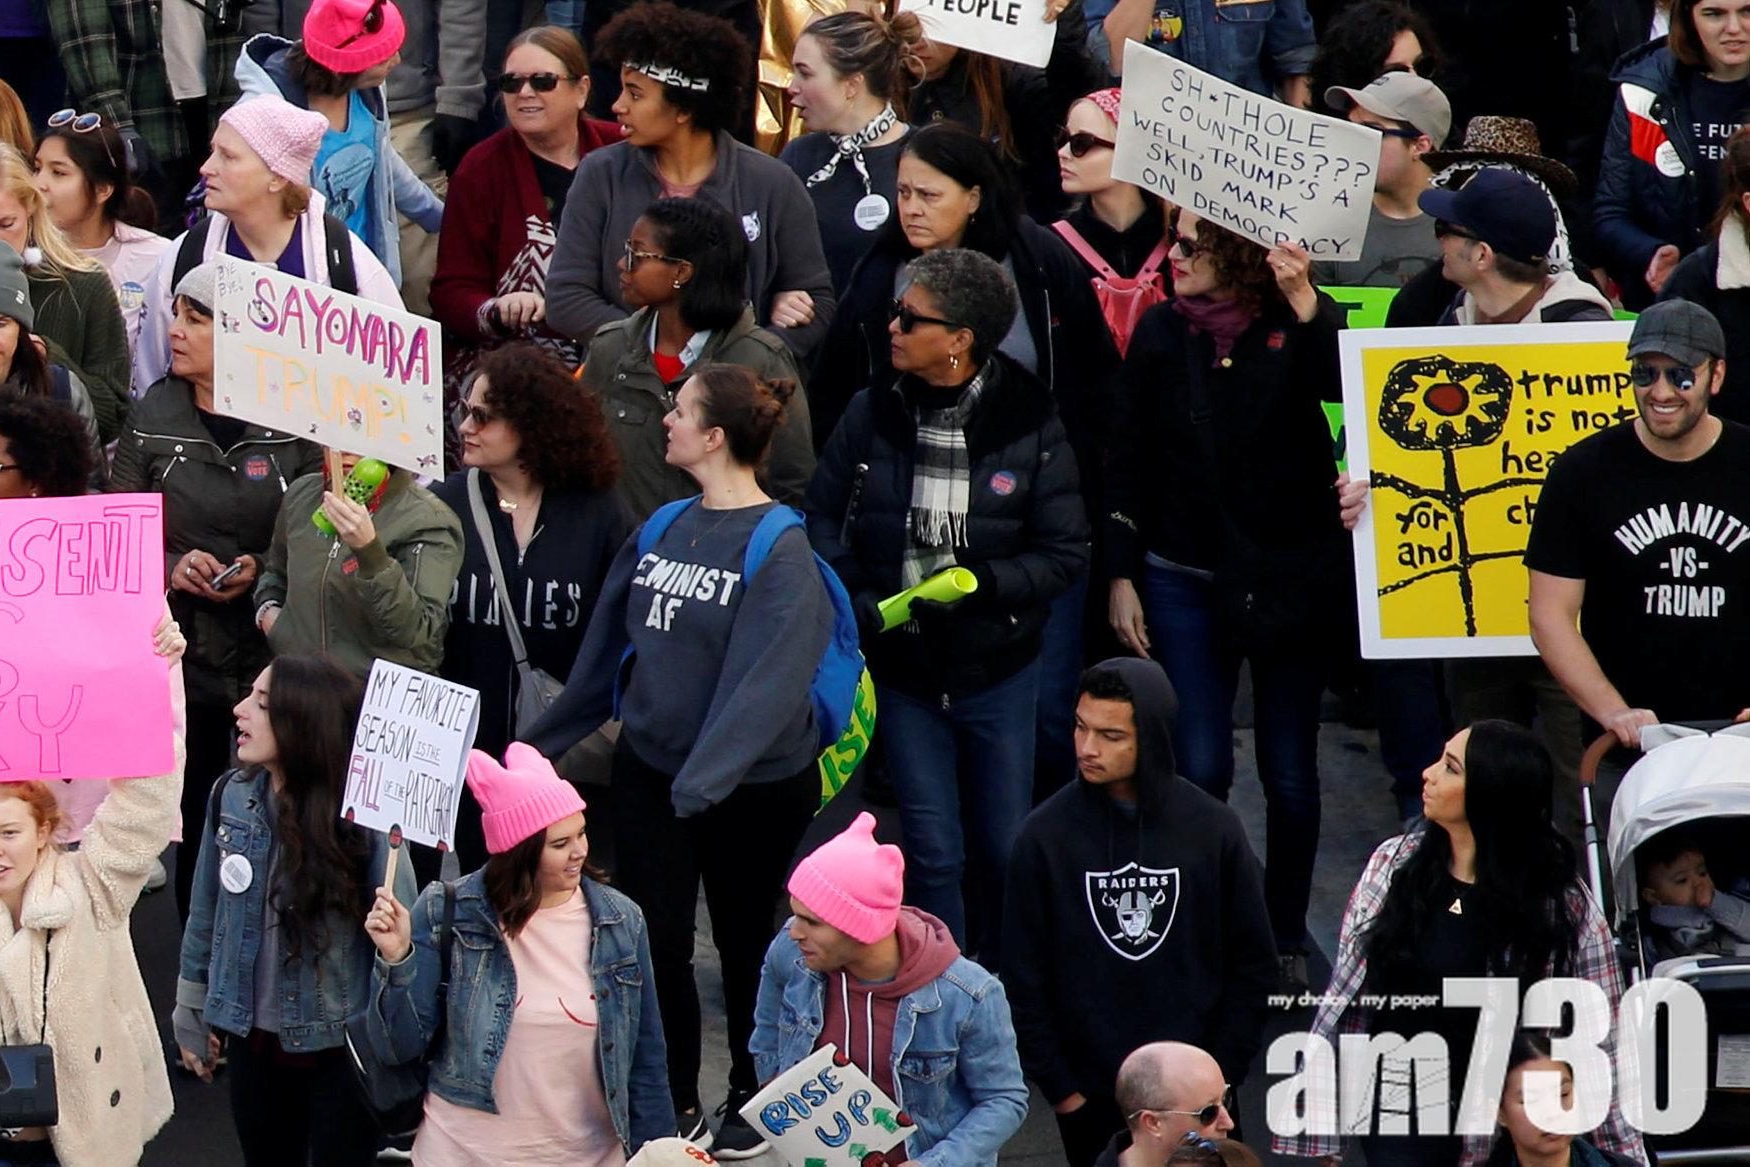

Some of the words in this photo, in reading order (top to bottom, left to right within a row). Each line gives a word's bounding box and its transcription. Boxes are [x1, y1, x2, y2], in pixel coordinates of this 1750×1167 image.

[1133, 110, 1204, 160] WELL,
[1208, 147, 1320, 201] TRUMP'S
[1332, 189, 1349, 208] A
[1161, 96, 1371, 188] COUNTRIES???
[1142, 168, 1176, 196] ON
[1147, 143, 1203, 182] SKID
[1221, 181, 1299, 224] MARK
[247, 277, 430, 385] SAYONARA
[243, 343, 412, 443] TRUMP!
[1517, 369, 1633, 398] trump
[1526, 408, 1555, 434] is
[1572, 403, 1639, 430] not
[1396, 500, 1449, 534] for
[1614, 502, 1750, 556] HUMANITY
[1397, 533, 1452, 568] and
[632, 552, 742, 606] EMINIST
[1644, 585, 1726, 618] TRUMP
[645, 594, 683, 632] AF
[369, 669, 401, 709] MY
[399, 676, 472, 732] FAVORITE
[356, 713, 417, 762] SEASON
[345, 754, 384, 812] FALL
[1098, 876, 1168, 889] RAIDERS
[760, 1066, 844, 1136] RISE
[815, 1089, 872, 1148] UP
